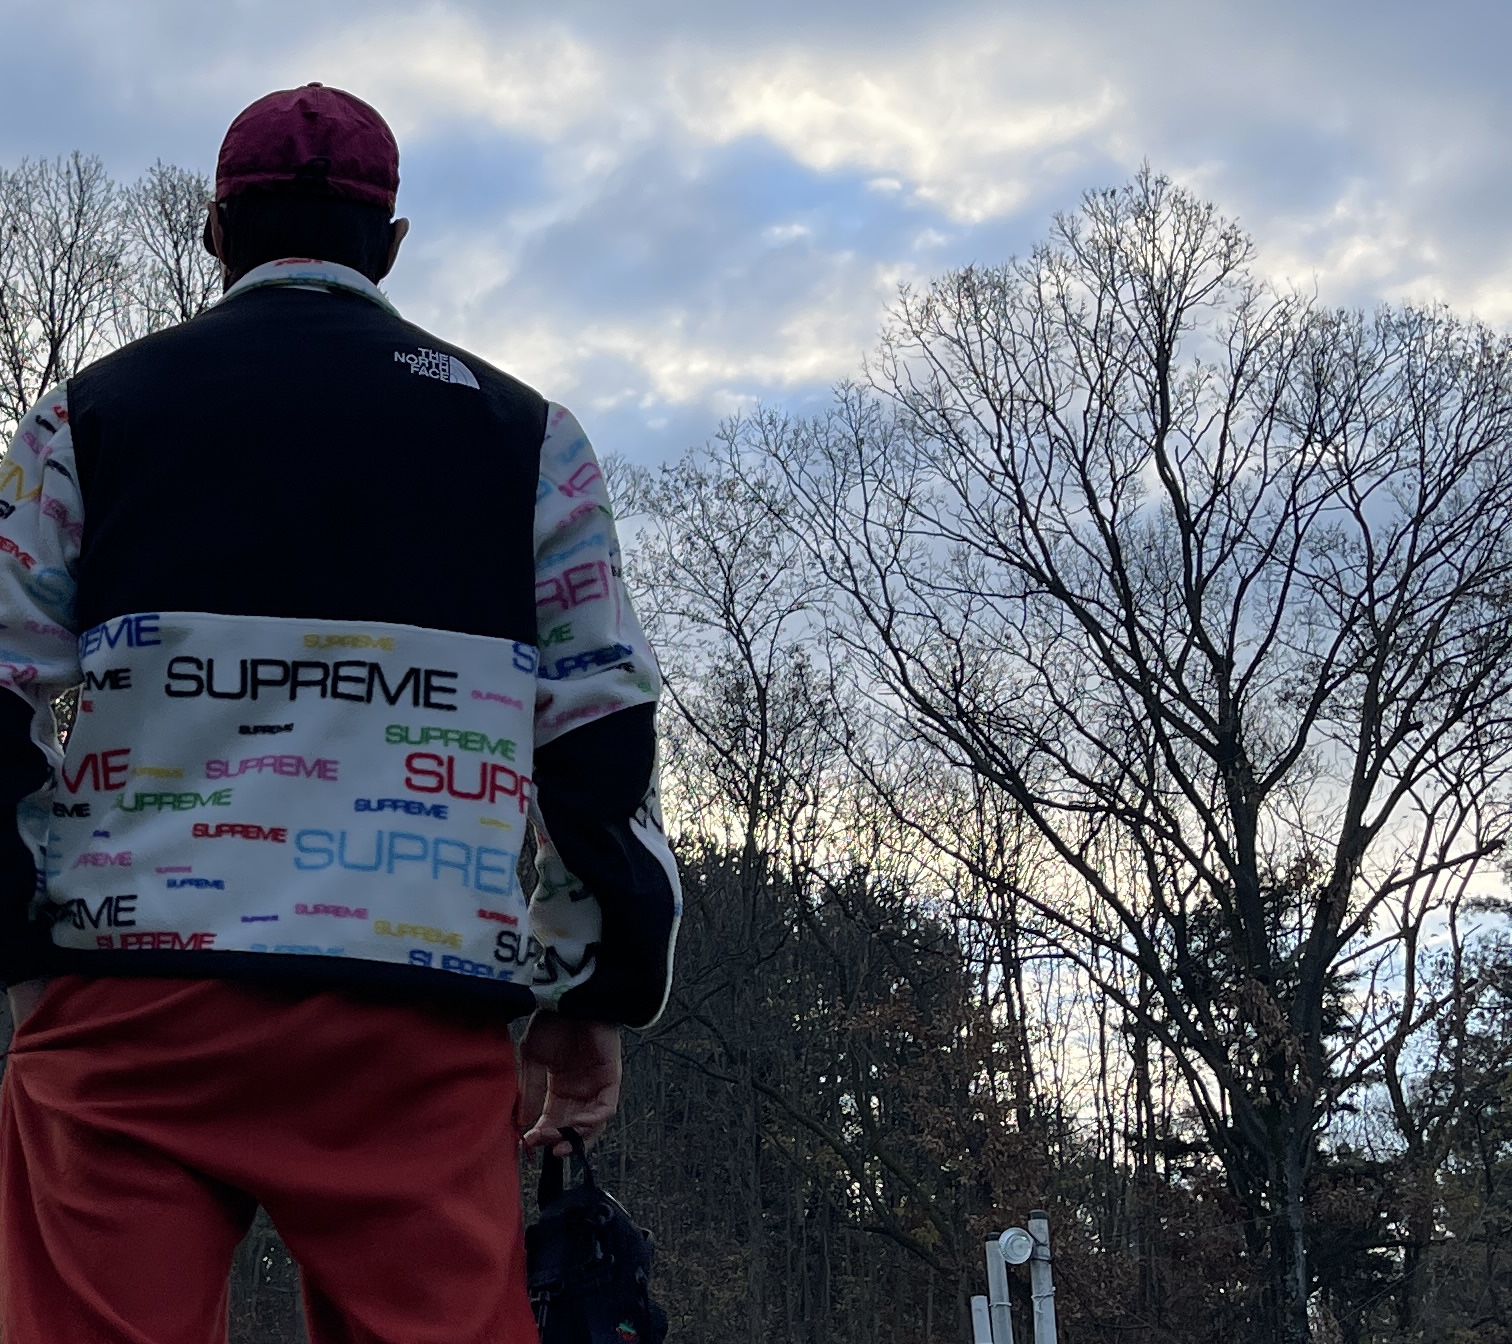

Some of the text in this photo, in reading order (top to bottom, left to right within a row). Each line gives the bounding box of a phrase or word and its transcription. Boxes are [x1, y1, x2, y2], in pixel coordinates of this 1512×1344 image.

[394, 351, 449, 373] NORTH
[418, 347, 449, 363] THE
[410, 363, 449, 383] FACE
[79, 614, 161, 657] EME
[85, 668, 132, 691] ME
[164, 656, 459, 712] SUPREME
[386, 724, 516, 762] SUPREME
[205, 755, 340, 782] SUPREME
[354, 798, 448, 820] SUPREME
[192, 822, 287, 843] SUPREME
[294, 829, 518, 897] SUPRE
[295, 903, 368, 920] SUPREME
[97, 932, 217, 951] SUPREME
